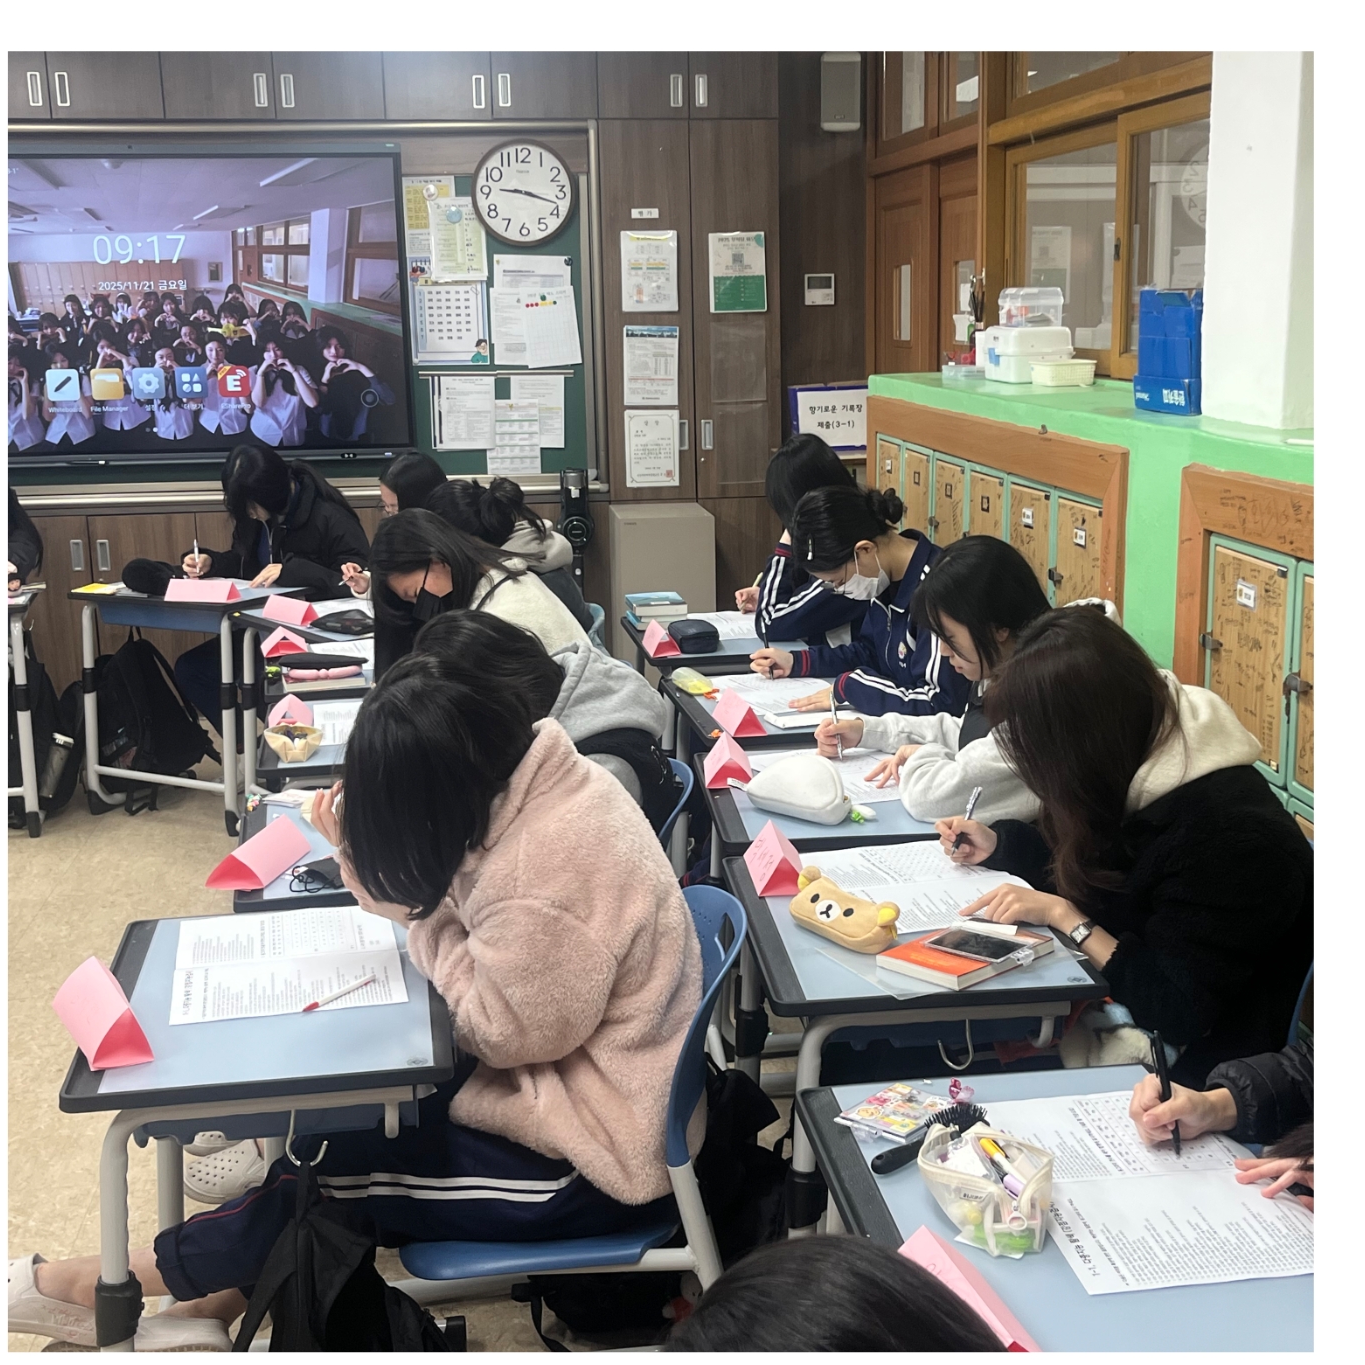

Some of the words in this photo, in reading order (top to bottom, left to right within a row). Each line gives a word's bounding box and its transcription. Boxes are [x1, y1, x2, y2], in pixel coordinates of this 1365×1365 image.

[500, 152, 510, 166] 11
[515, 147, 531, 164] 12
[485, 167, 502, 182] 10
[550, 167, 561, 182] 2
[480, 185, 491, 199] 9
[555, 185, 566, 199] 3
[487, 204, 498, 218] 8
[549, 205, 560, 218] 4
[502, 218, 511, 232] 7
[520, 223, 530, 236] 6
[537, 218, 548, 231] 5
[93, 235, 186, 265] 09:17
[98, 281, 155, 292] 2025/11/21
[158, 279, 187, 291] 금요일
[104, 405, 128, 413] Manager
[809, 405, 837, 414] 향기로운
[842, 404, 863, 413] 기록장
[817, 420, 855, 429] 제출(3-1)
